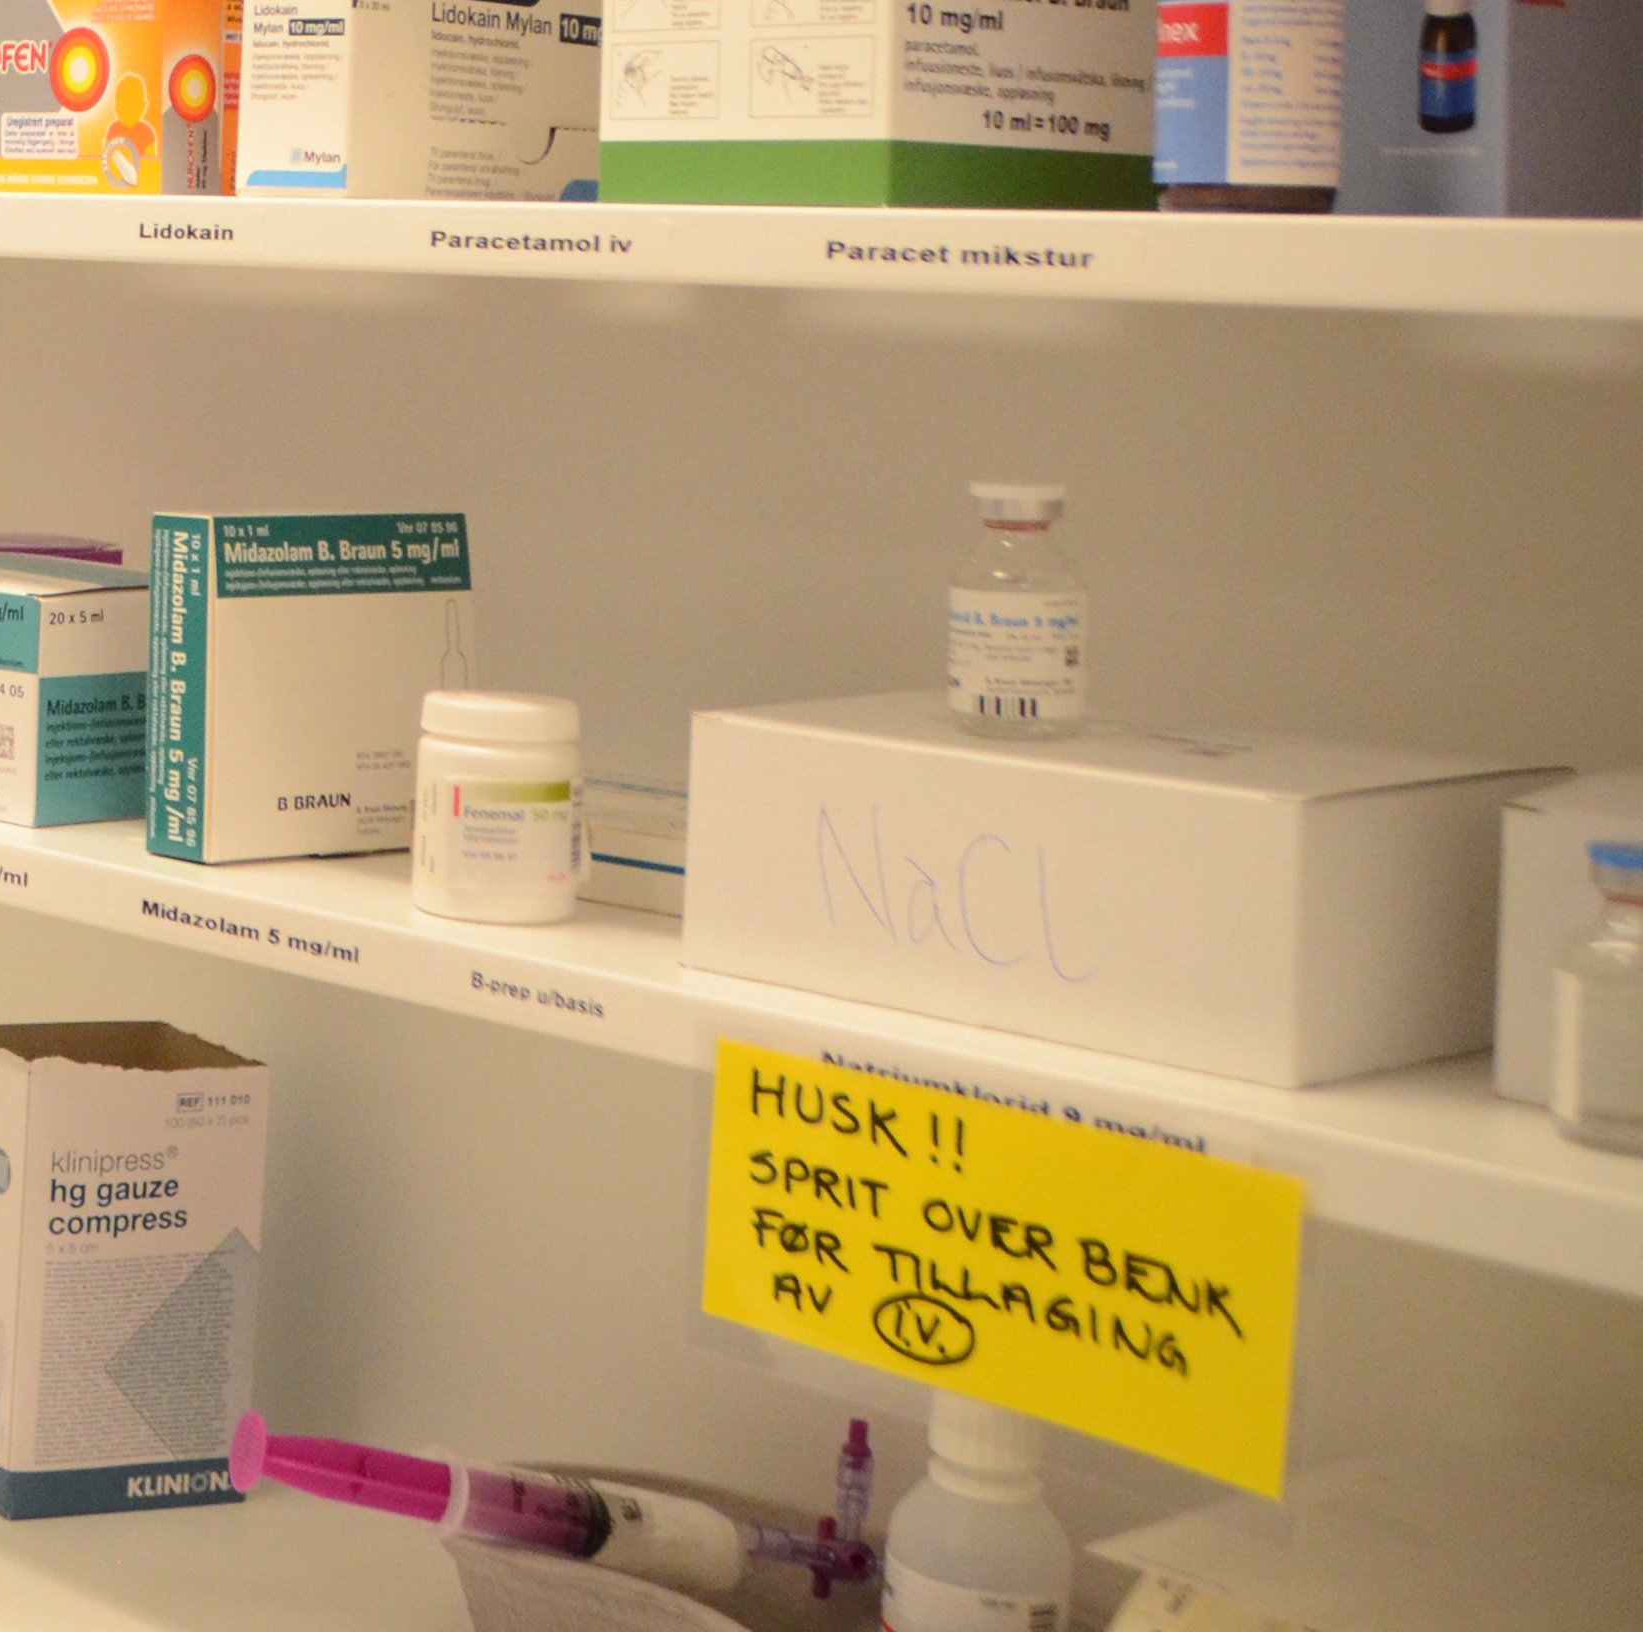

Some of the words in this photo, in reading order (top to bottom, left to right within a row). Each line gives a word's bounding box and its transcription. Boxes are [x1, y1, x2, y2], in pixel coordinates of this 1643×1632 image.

[253, 4, 299, 16] Lidokain
[431, 2, 501, 30] Lidokain
[505, 11, 553, 37] Mylan
[561, 17, 580, 40] 10
[906, 3, 933, 26] 10
[253, 22, 284, 36] Mylan
[289, 21, 303, 34] 10
[304, 20, 345, 36] mg/ml
[1157, 19, 1200, 44] nex
[982, 109, 1005, 131] 10
[1084, 119, 1110, 142] mg
[303, 150, 342, 166] Mylan
[139, 222, 235, 242] Lidokain
[430, 229, 601, 253] Paracetamol
[610, 235, 633, 253] iv
[826, 239, 949, 264] Paracet
[961, 245, 1094, 270] mikstur
[223, 524, 236, 538] 10
[255, 523, 269, 537] ml
[396, 520, 413, 535] Vnr
[223, 540, 313, 564] Midazolam
[317, 541, 335, 562] B.
[339, 538, 386, 561] Braun
[391, 539, 402, 559] 5
[407, 535, 459, 564] mg/ml
[171, 530, 190, 645] Midazolam
[48, 611, 66, 626] 20
[68, 612, 76, 624] x
[78, 610, 88, 624] 5
[89, 608, 105, 624] ml
[170, 650, 187, 673] B.
[8, 683, 26, 699] 05
[46, 696, 117, 717] Midazolam
[120, 693, 135, 711] B.
[169, 678, 187, 741] Braun
[169, 748, 184, 764] 5
[277, 797, 289, 812] B
[293, 792, 352, 811] BRAUN
[463, 805, 525, 823] Fenemal
[816, 802, 1096, 984] NaCl
[141, 899, 260, 941] Midazolam
[268, 927, 281, 945] 5
[288, 936, 360, 964] mg/ml
[537, 990, 605, 1019] u/basis
[207, 1095, 227, 1106] 111
[749, 1066, 909, 1158] HUSK
[49, 1178, 86, 1208] hg
[96, 1178, 180, 1204] gauze
[48, 1209, 189, 1240] compress
[749, 1150, 888, 1218] SPRIT
[921, 1199, 1057, 1271] OVER
[1078, 1239, 1246, 1339] BENK
[751, 1207, 849, 1273] FØR
[872, 1243, 1191, 1378] TILLAGING
[772, 1274, 833, 1314] AV
[126, 1470, 230, 1500] KLINION
